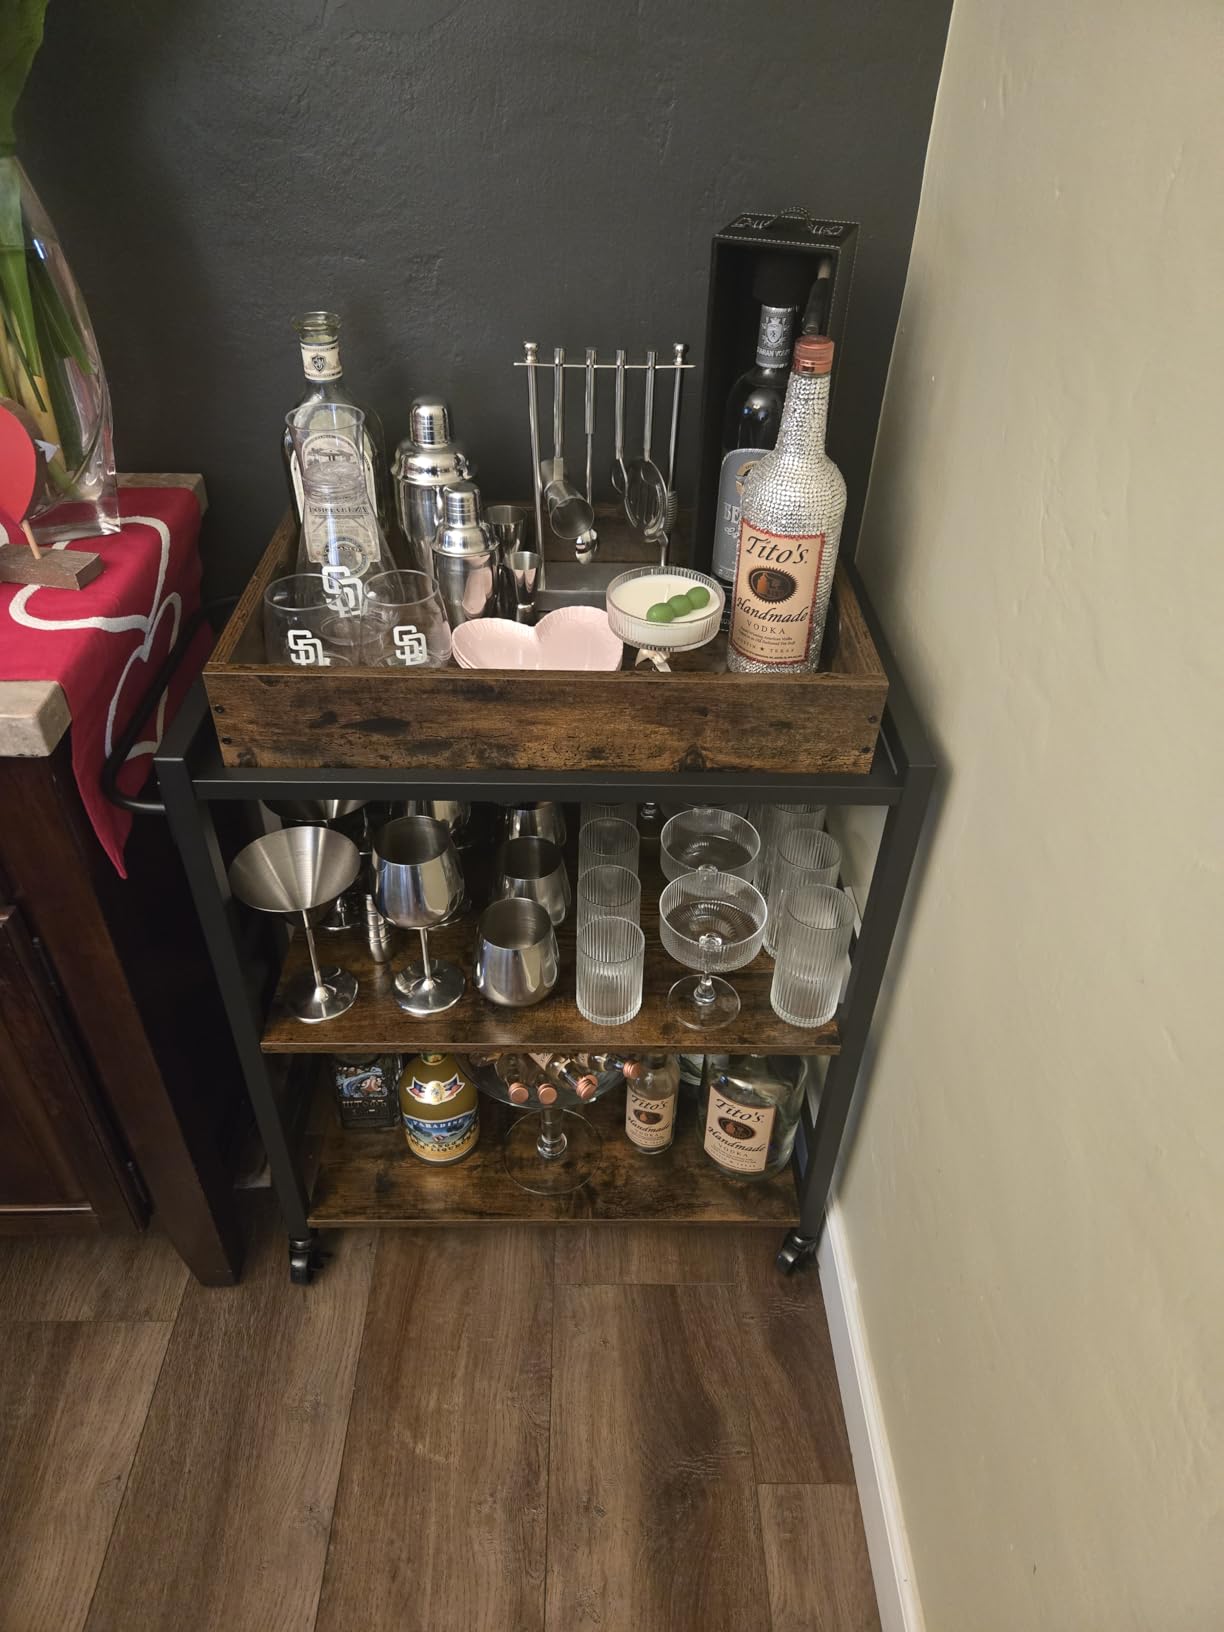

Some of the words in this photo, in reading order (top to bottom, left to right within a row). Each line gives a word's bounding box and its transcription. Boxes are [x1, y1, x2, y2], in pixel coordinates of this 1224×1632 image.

[745, 535, 809, 565] Tito's
[736, 597, 809, 623] Handmade
[746, 619, 786, 635] VODKA
[631, 1094, 668, 1111] Tito's
[715, 1098, 765, 1124] Tito's
[412, 1118, 464, 1129] PARADISE
[628, 1115, 671, 1133] Handmade
[707, 1126, 766, 1152] Handmade
[718, 1142, 749, 1158] VODKA
